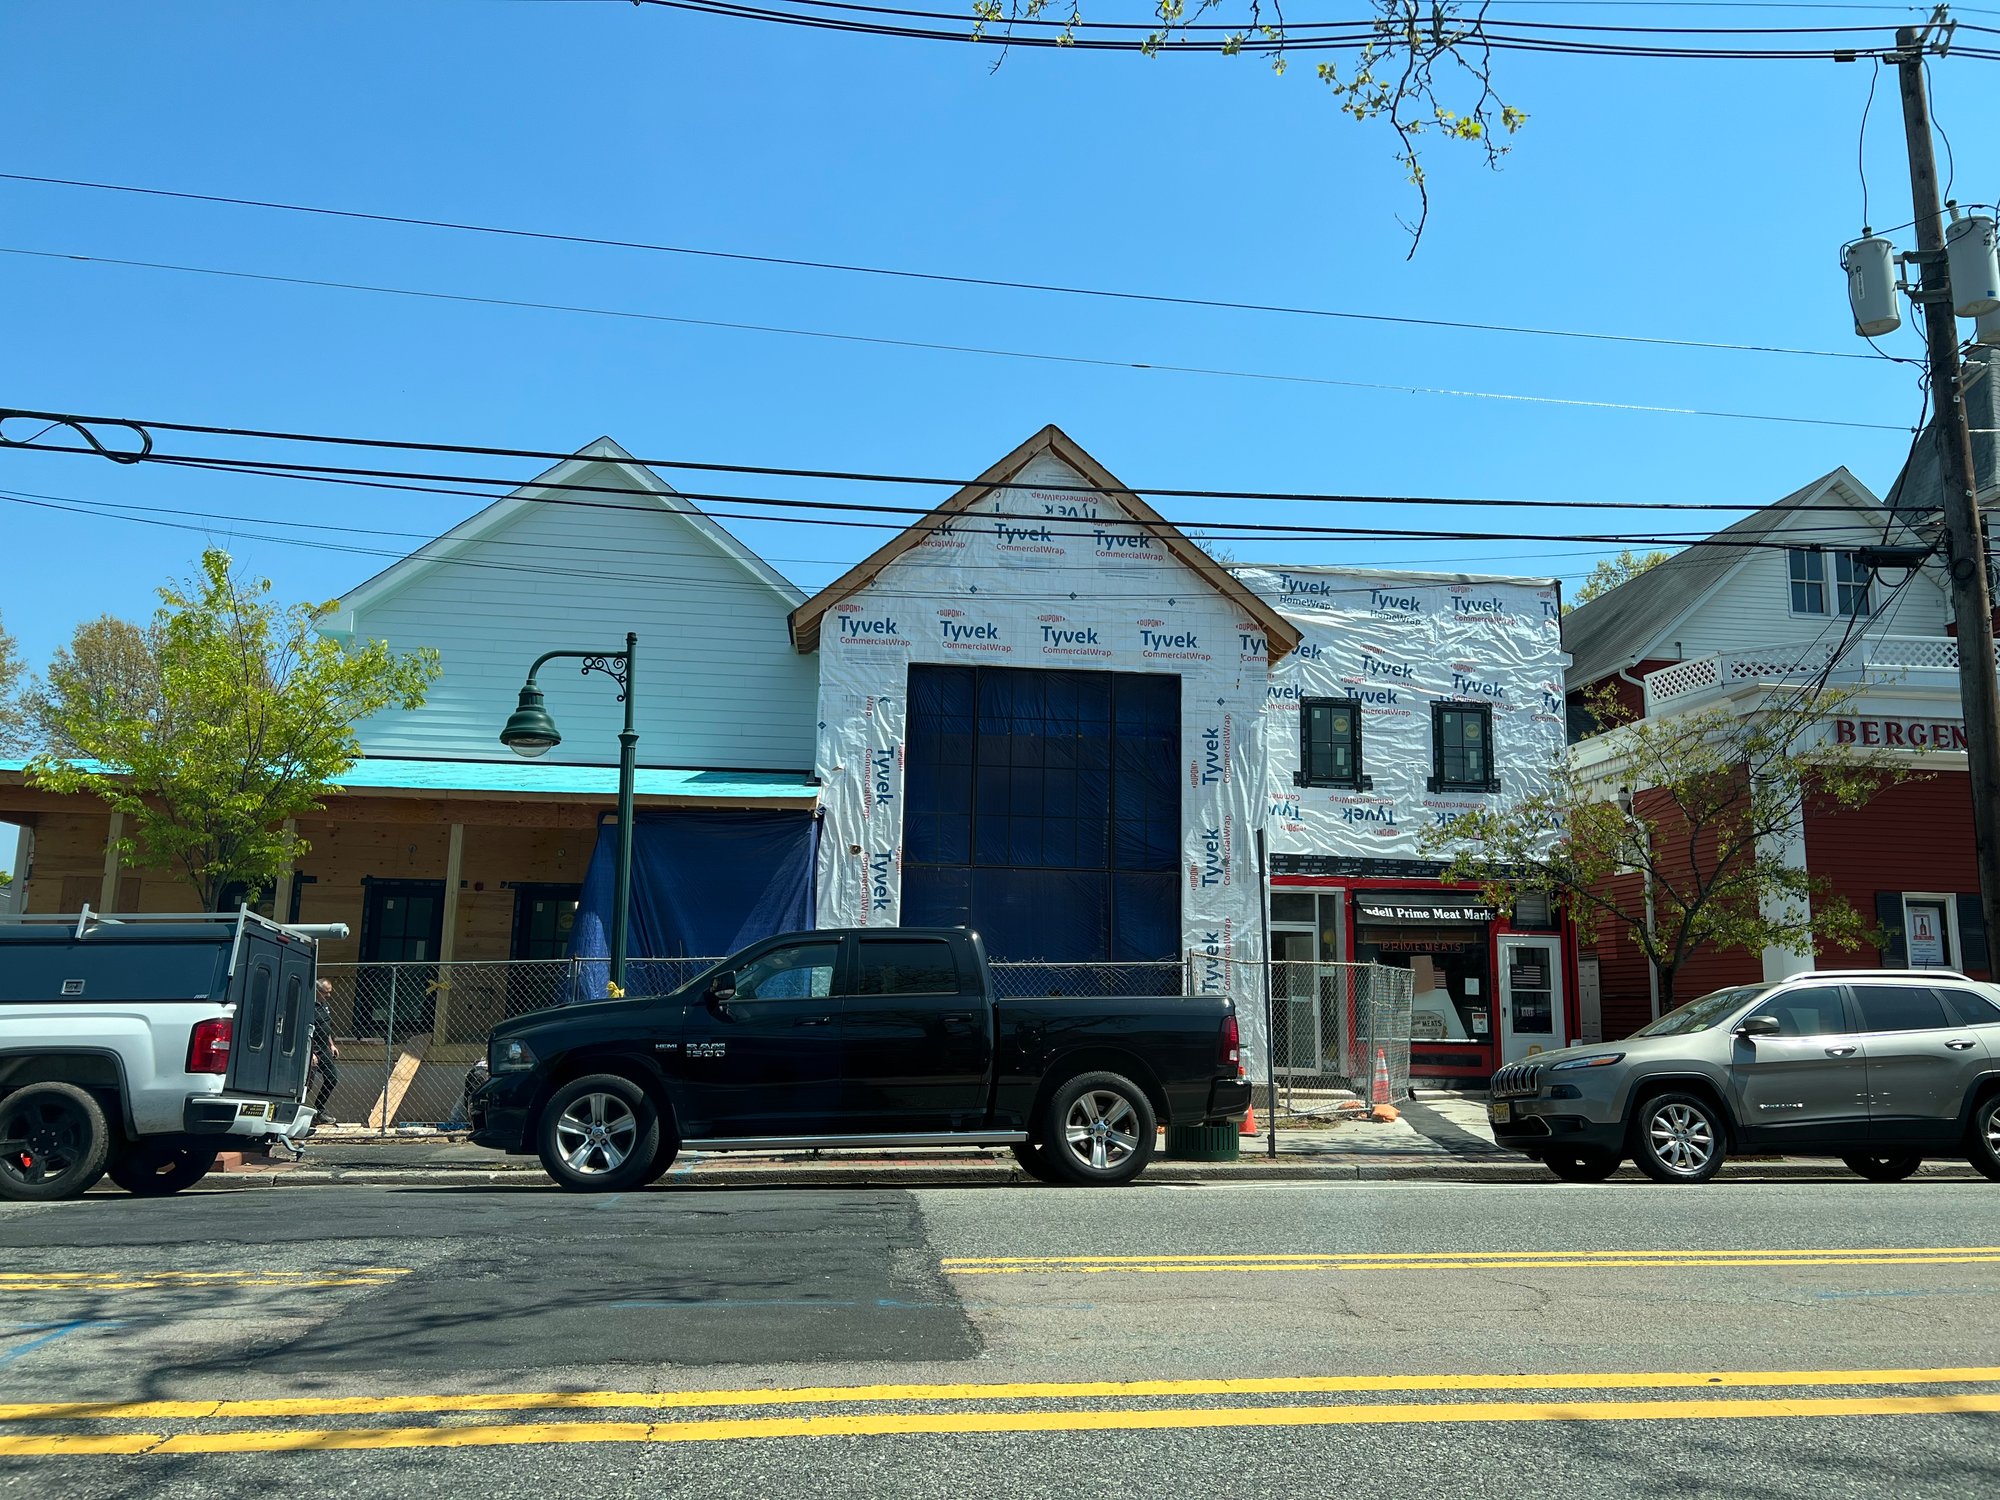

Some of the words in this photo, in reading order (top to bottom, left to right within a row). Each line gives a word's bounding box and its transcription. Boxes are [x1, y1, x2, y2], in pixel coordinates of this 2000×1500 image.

[994, 523, 1051, 544] Tyvek
[1093, 529, 1150, 551] Tyvek
[920, 540, 966, 549] ercialWrap
[996, 543, 1065, 555] CommercialWrap
[1095, 549, 1164, 561] CommercialWrap
[1279, 573, 1331, 597] Tyvek
[837, 604, 861, 613] DUPONT
[1280, 594, 1332, 611] HomeWrap
[1370, 589, 1421, 614] Tyvek
[1451, 596, 1504, 615] Tyvek
[940, 609, 963, 618] DUPONT
[1040, 614, 1063, 623] DUPONT
[1140, 618, 1162, 627] DUPONT
[837, 615, 898, 637] Tyvek
[940, 620, 998, 642] Tyvek
[1040, 625, 1098, 647] Tyvek
[839, 636, 911, 647] CommercialWrap
[942, 641, 1012, 652] CommercialWrap
[1140, 630, 1198, 651] Tyvek
[1042, 646, 1112, 658] CommercialWrap
[1142, 649, 1212, 661] CommercialWrap
[1361, 654, 1413, 679] Tyvek
[1452, 673, 1503, 698] Tyvek
[1836, 719, 1968, 749] BERGEN
[1201, 727, 1224, 786] Tyvek
[1223, 714, 1232, 784] CommercialWrap
[863, 748, 873, 820] CommercialWrap
[872, 746, 895, 806] Tyvek
[1342, 805, 1397, 826] Tyvek
[1201, 829, 1224, 888] Tyvek
[869, 850, 892, 911] Tyvek
[1397, 907, 1430, 919] Prime
[1432, 908, 1461, 920] Meat
[1464, 908, 1496, 921] Marke
[1382, 941, 1420, 951] PRIME
[1201, 932, 1224, 993] Tyvek
[686, 1050, 726, 1058] 1500
